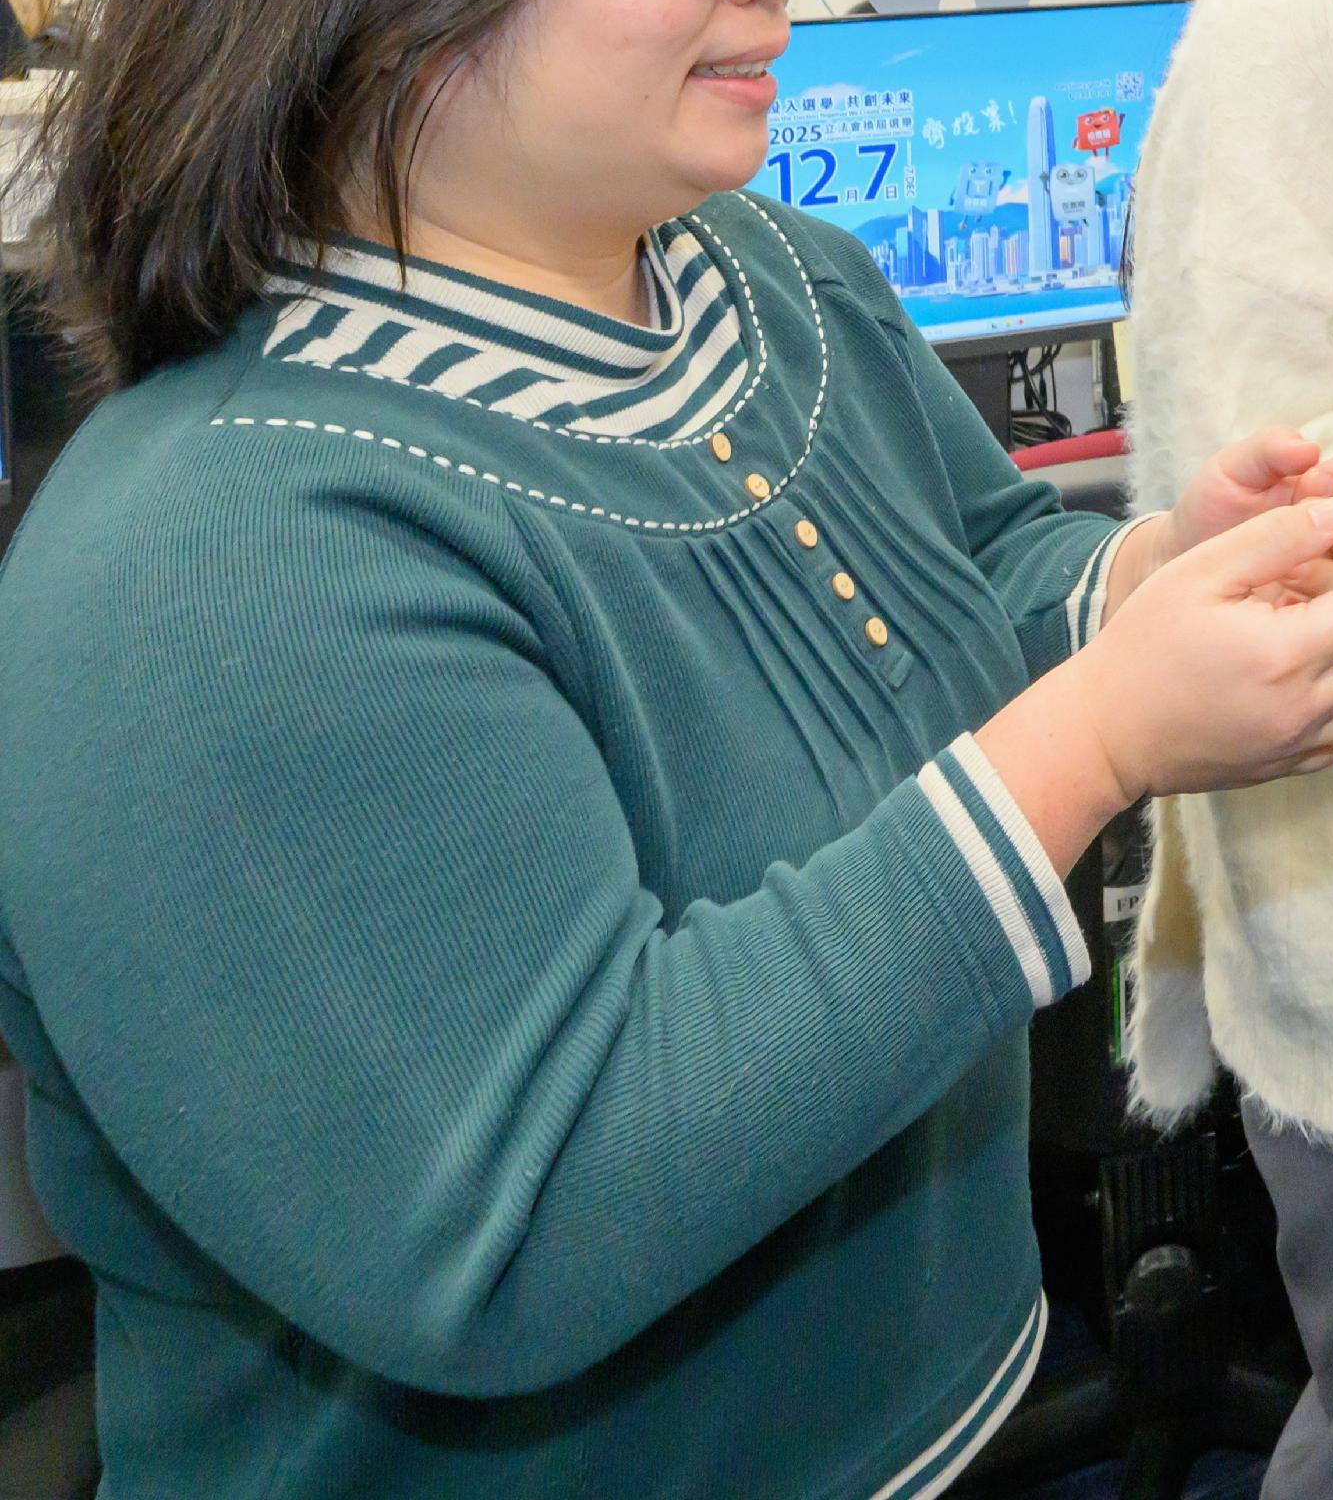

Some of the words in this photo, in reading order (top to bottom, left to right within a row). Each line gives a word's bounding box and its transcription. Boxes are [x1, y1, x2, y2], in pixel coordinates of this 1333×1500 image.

[847, 91, 911, 108] 共創未來
[769, 124, 822, 146] 2025
